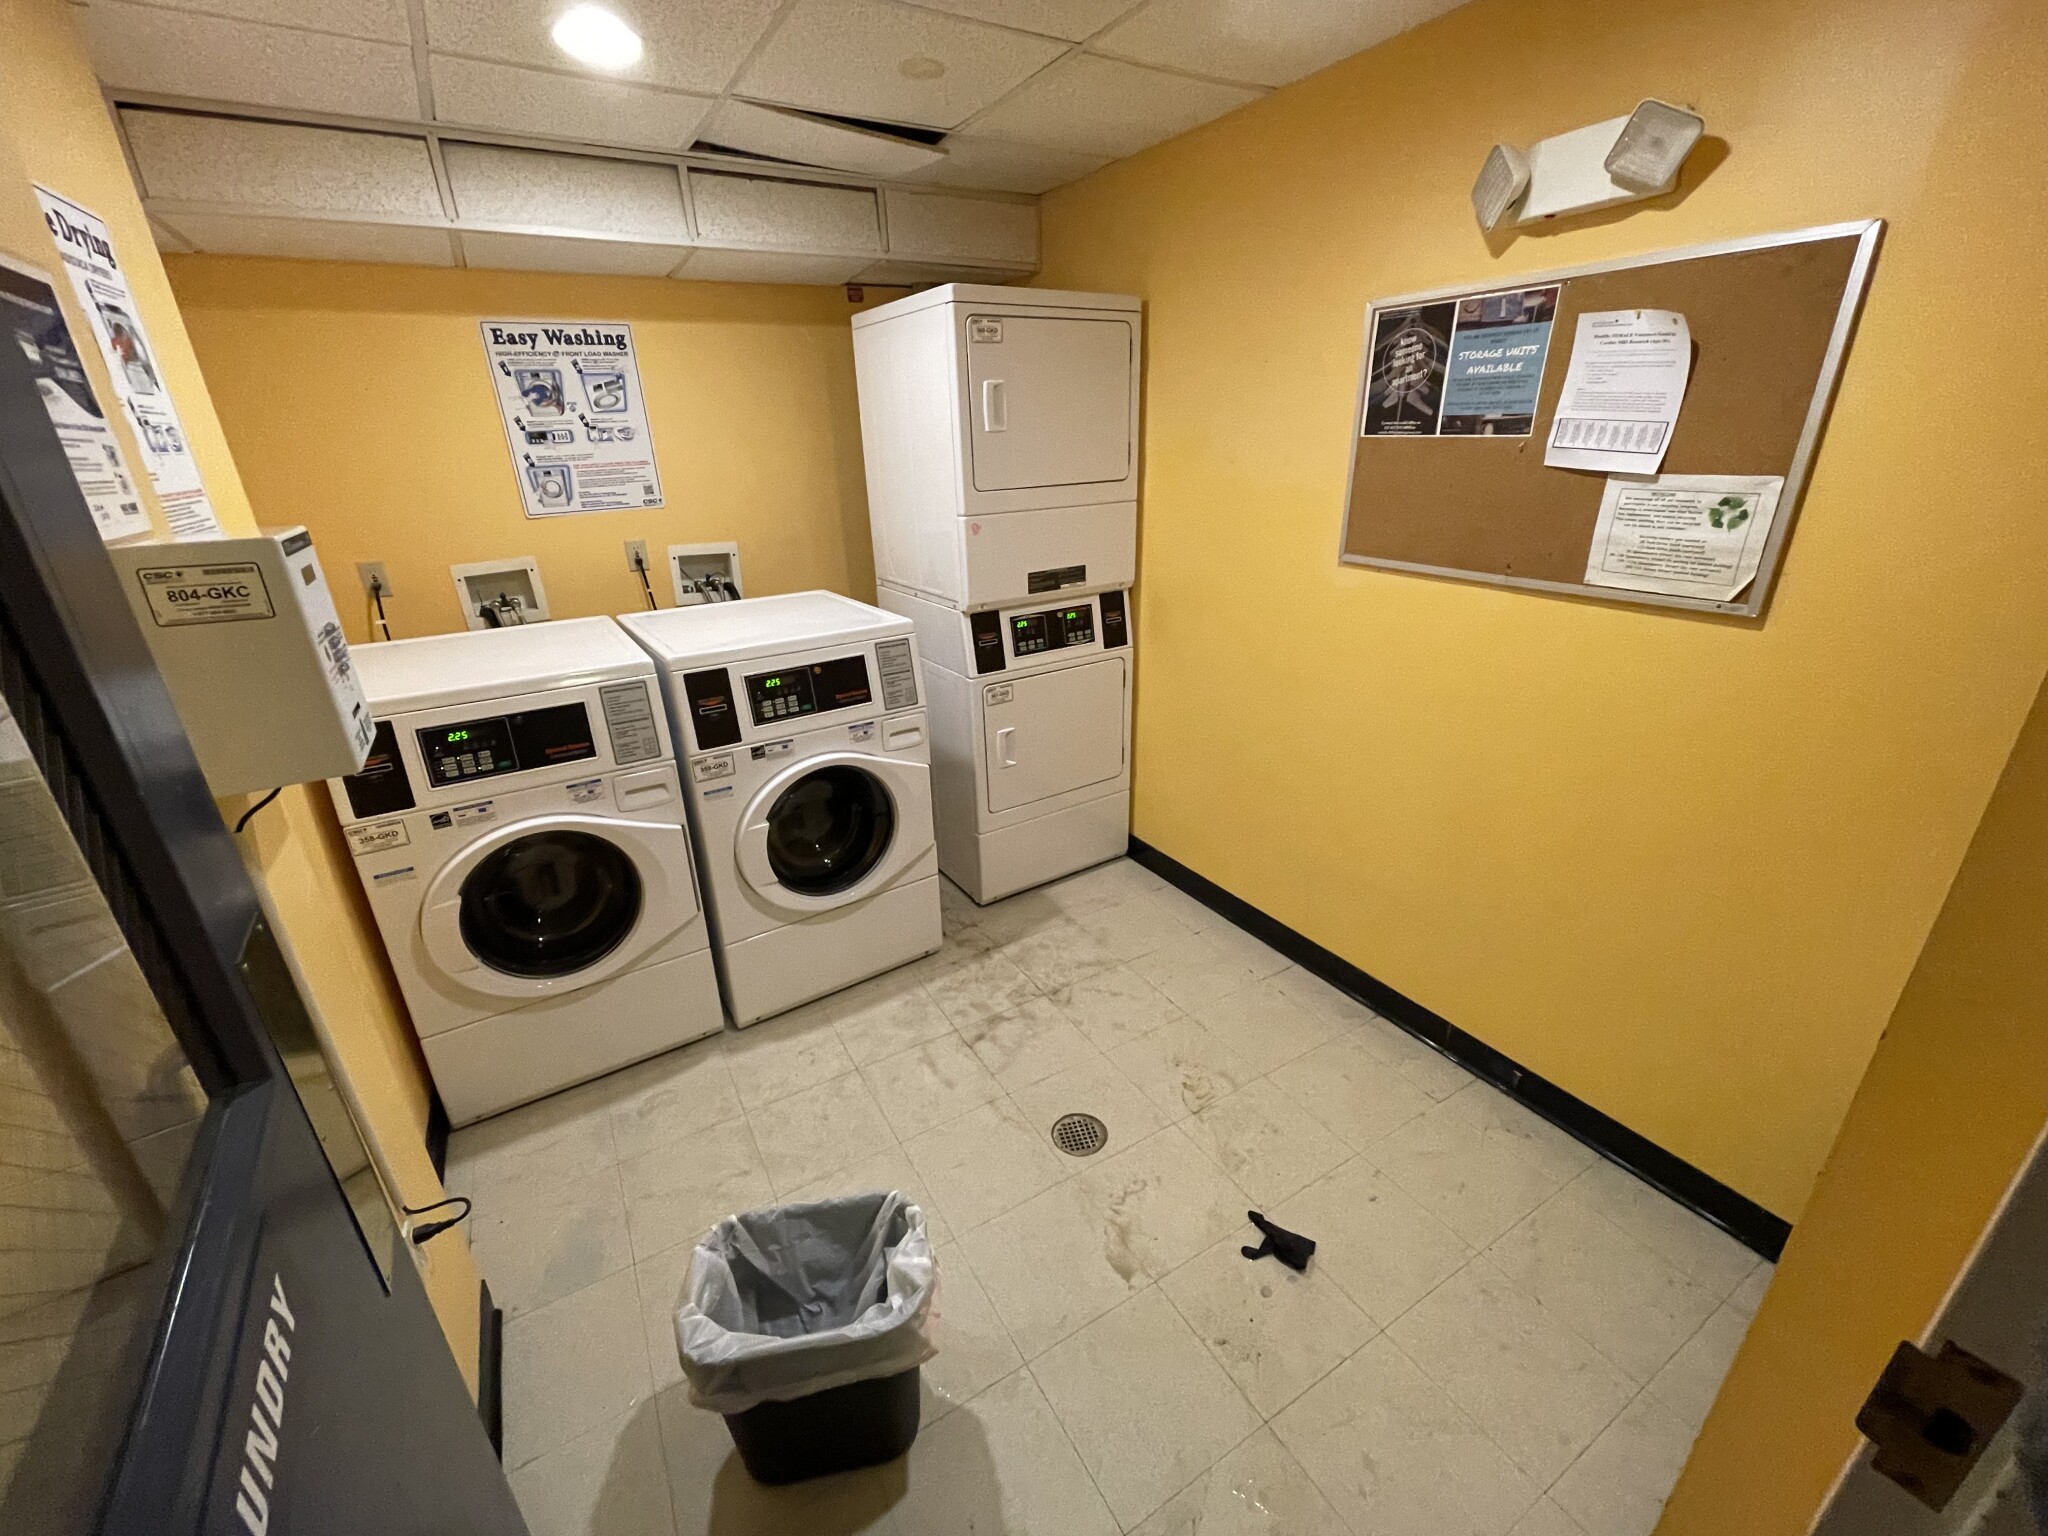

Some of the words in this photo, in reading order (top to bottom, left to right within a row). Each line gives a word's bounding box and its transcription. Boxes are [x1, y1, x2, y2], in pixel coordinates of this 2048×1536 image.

[52, 208, 116, 269] Drying
[489, 328, 538, 350] Easy
[541, 328, 627, 350] Washing
[1415, 351, 1425, 360] for
[1458, 348, 1504, 360] STORAGE
[1505, 345, 1540, 356] UNITS
[1466, 362, 1525, 375] AVAILABLE
[166, 586, 250, 602] 804-GKC
[765, 677, 781, 688] 2.25
[448, 730, 468, 742] 2.25
[358, 830, 399, 844] 358-GKD
